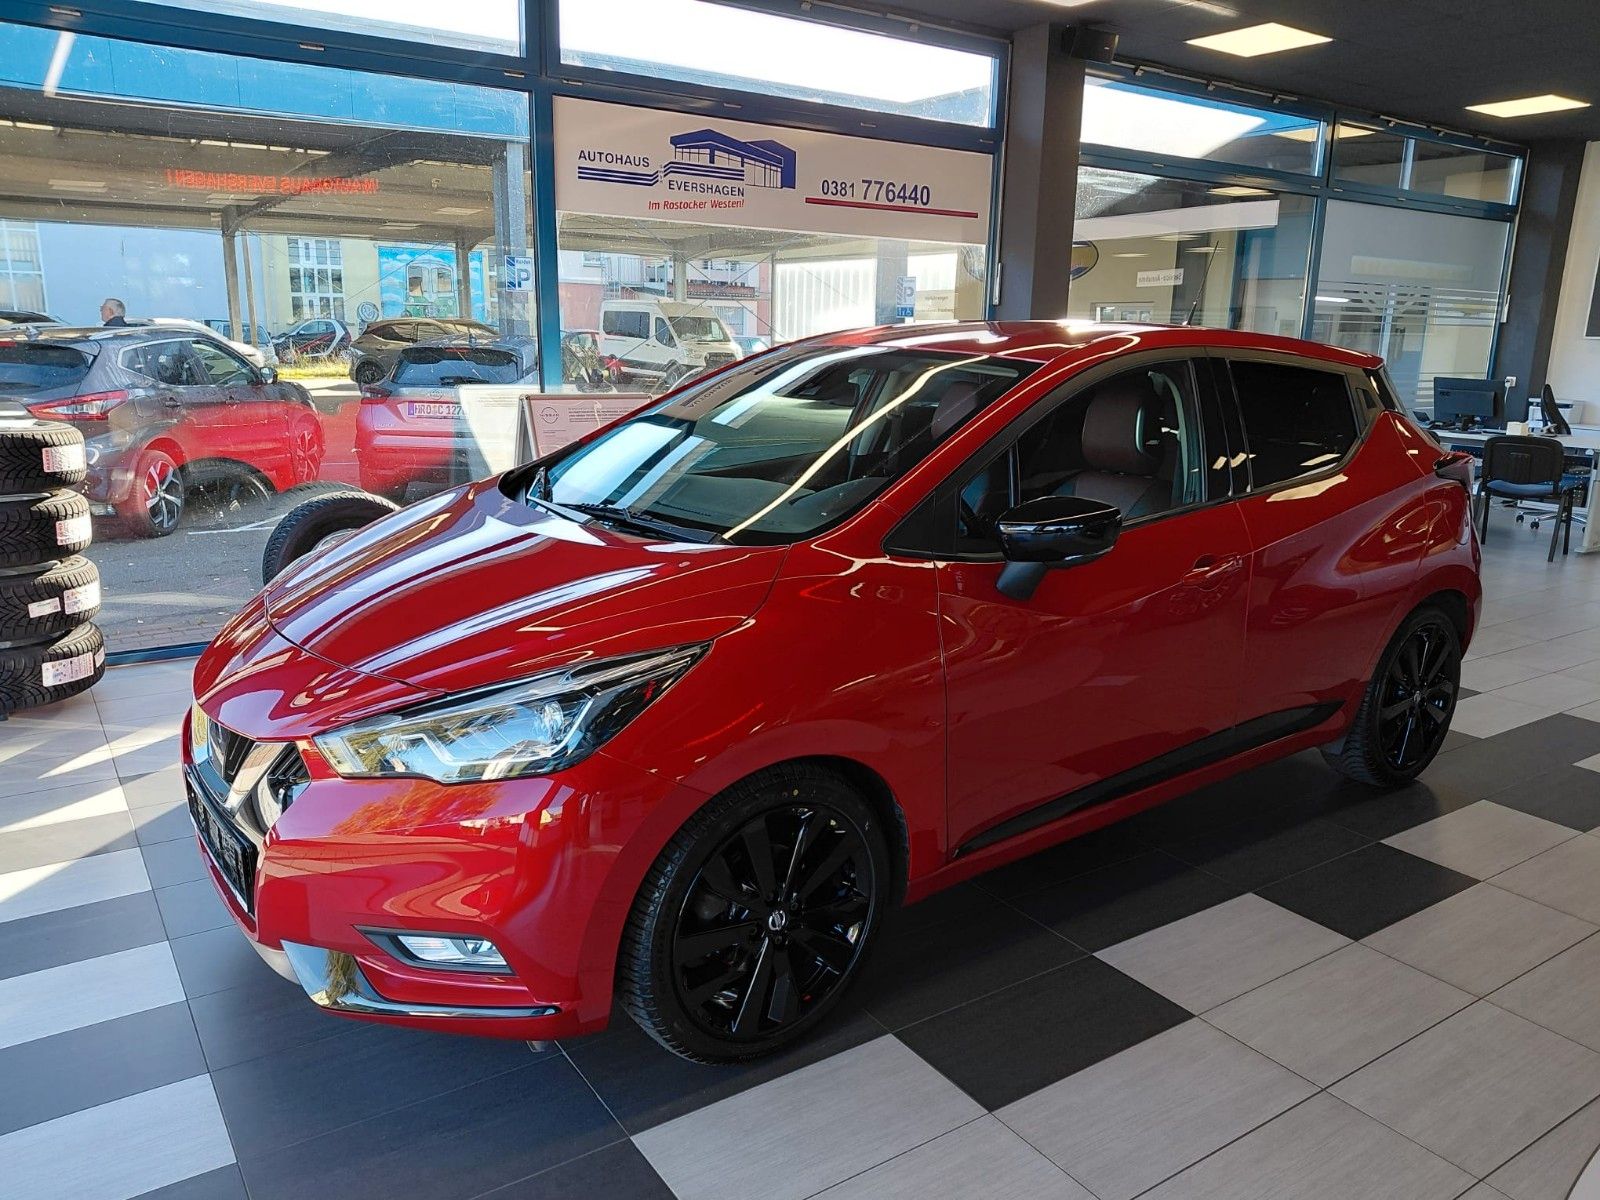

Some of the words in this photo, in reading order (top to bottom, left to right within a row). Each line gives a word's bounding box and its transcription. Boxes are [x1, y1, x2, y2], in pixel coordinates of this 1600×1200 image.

[578, 150, 650, 168] AUTOHAUS
[668, 179, 745, 198] EVERSHAGEN
[821, 179, 856, 198] 0381
[861, 179, 931, 206] 776440
[648, 200, 660, 210] Im
[663, 200, 707, 210] Rostocker
[710, 199, 745, 209] Westen!
[517, 269, 531, 288] P
[446, 405, 465, 416] 127
